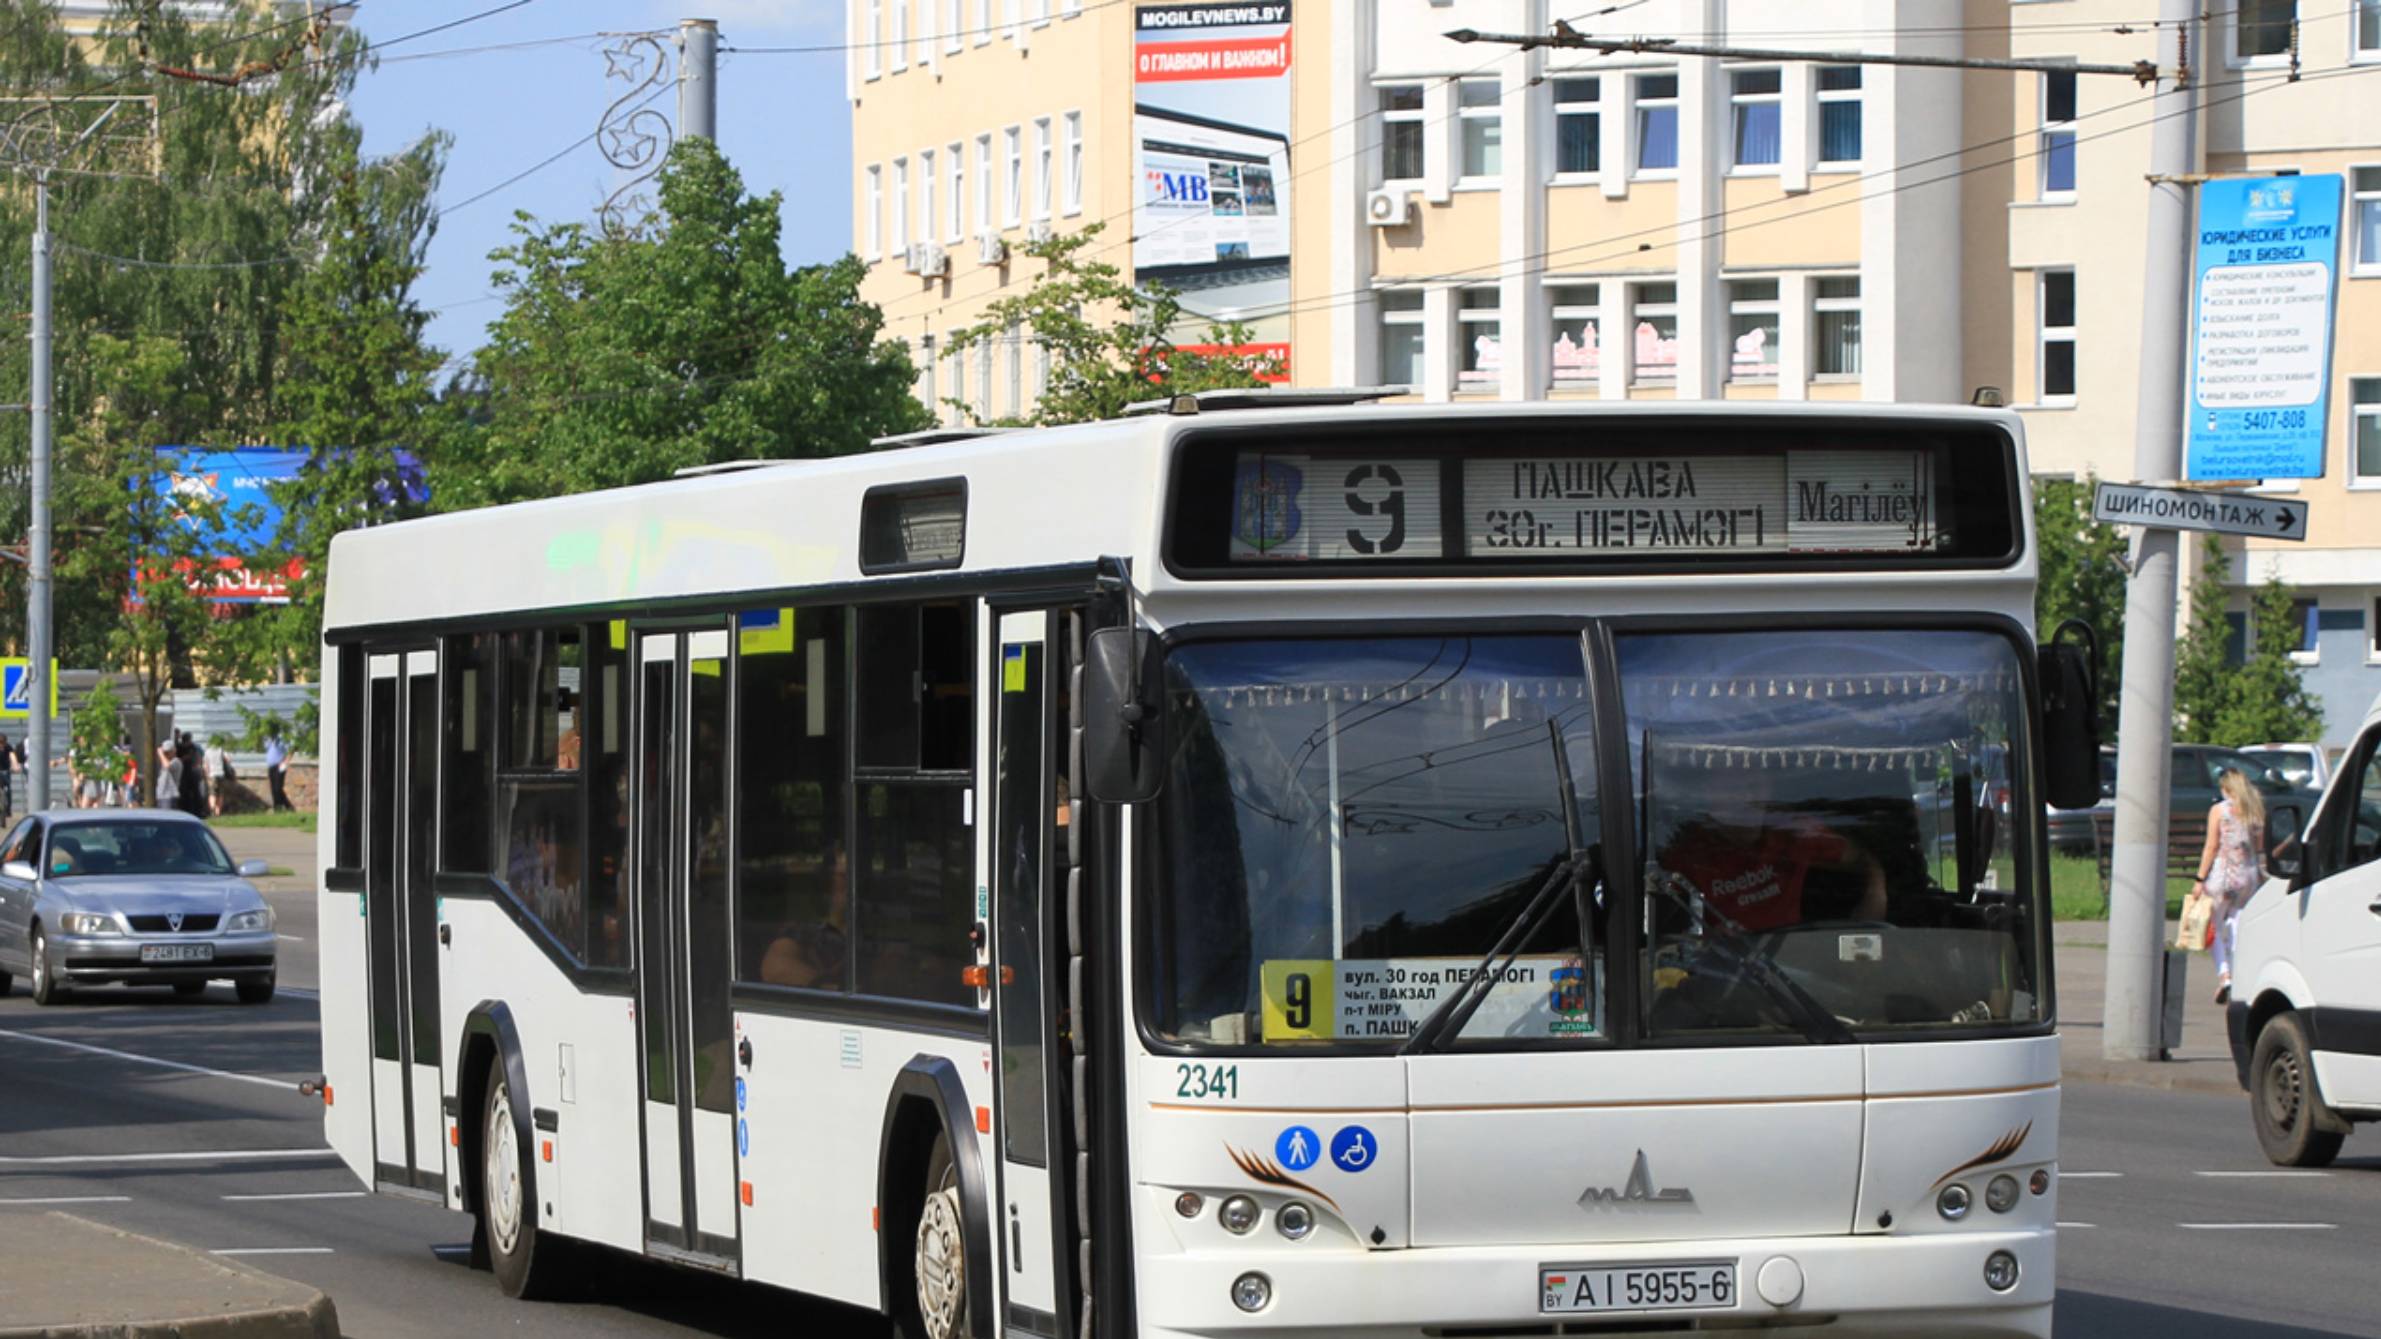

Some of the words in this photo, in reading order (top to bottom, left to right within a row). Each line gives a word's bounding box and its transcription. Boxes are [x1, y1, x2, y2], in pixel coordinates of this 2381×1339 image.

[1141, 6, 1286, 28] MOGILEVNEWS.BY
[1140, 54, 1150, 73] О
[1151, 51, 1209, 72] ГЛАВНОМ
[1211, 50, 1221, 70] И
[2201, 228, 2286, 246] ЮРИДИЧЕСКИЕ
[2290, 225, 2332, 240] УСЛУГИ
[2226, 249, 2251, 264] ДЛЯ
[2256, 246, 2306, 262] БИЗНЕСА
[2243, 409, 2306, 431] 5407-808
[1512, 459, 1697, 500] ПАШКАВА
[1343, 463, 1406, 555] 9
[2104, 493, 2266, 527] ШИНОМОНТАЖ
[1575, 503, 1764, 549] ПЕРАМОГІ
[1711, 864, 1777, 896] Reebok
[1344, 971, 1380, 987] вул.
[1386, 968, 1406, 984] 30
[1411, 971, 1440, 986] год
[1286, 973, 1312, 1030] 9
[1379, 987, 1436, 1000] ВАКЗАЛ
[1344, 1005, 1364, 1016] п-т
[1368, 1003, 1402, 1016] МІРУ
[1344, 1023, 1361, 1036] п.
[1366, 1020, 1419, 1036] ПАШК
[1176, 1062, 1238, 1099] 2341
[1545, 1293, 1563, 1308] BY
[1626, 1270, 1730, 1305] 5955-6
